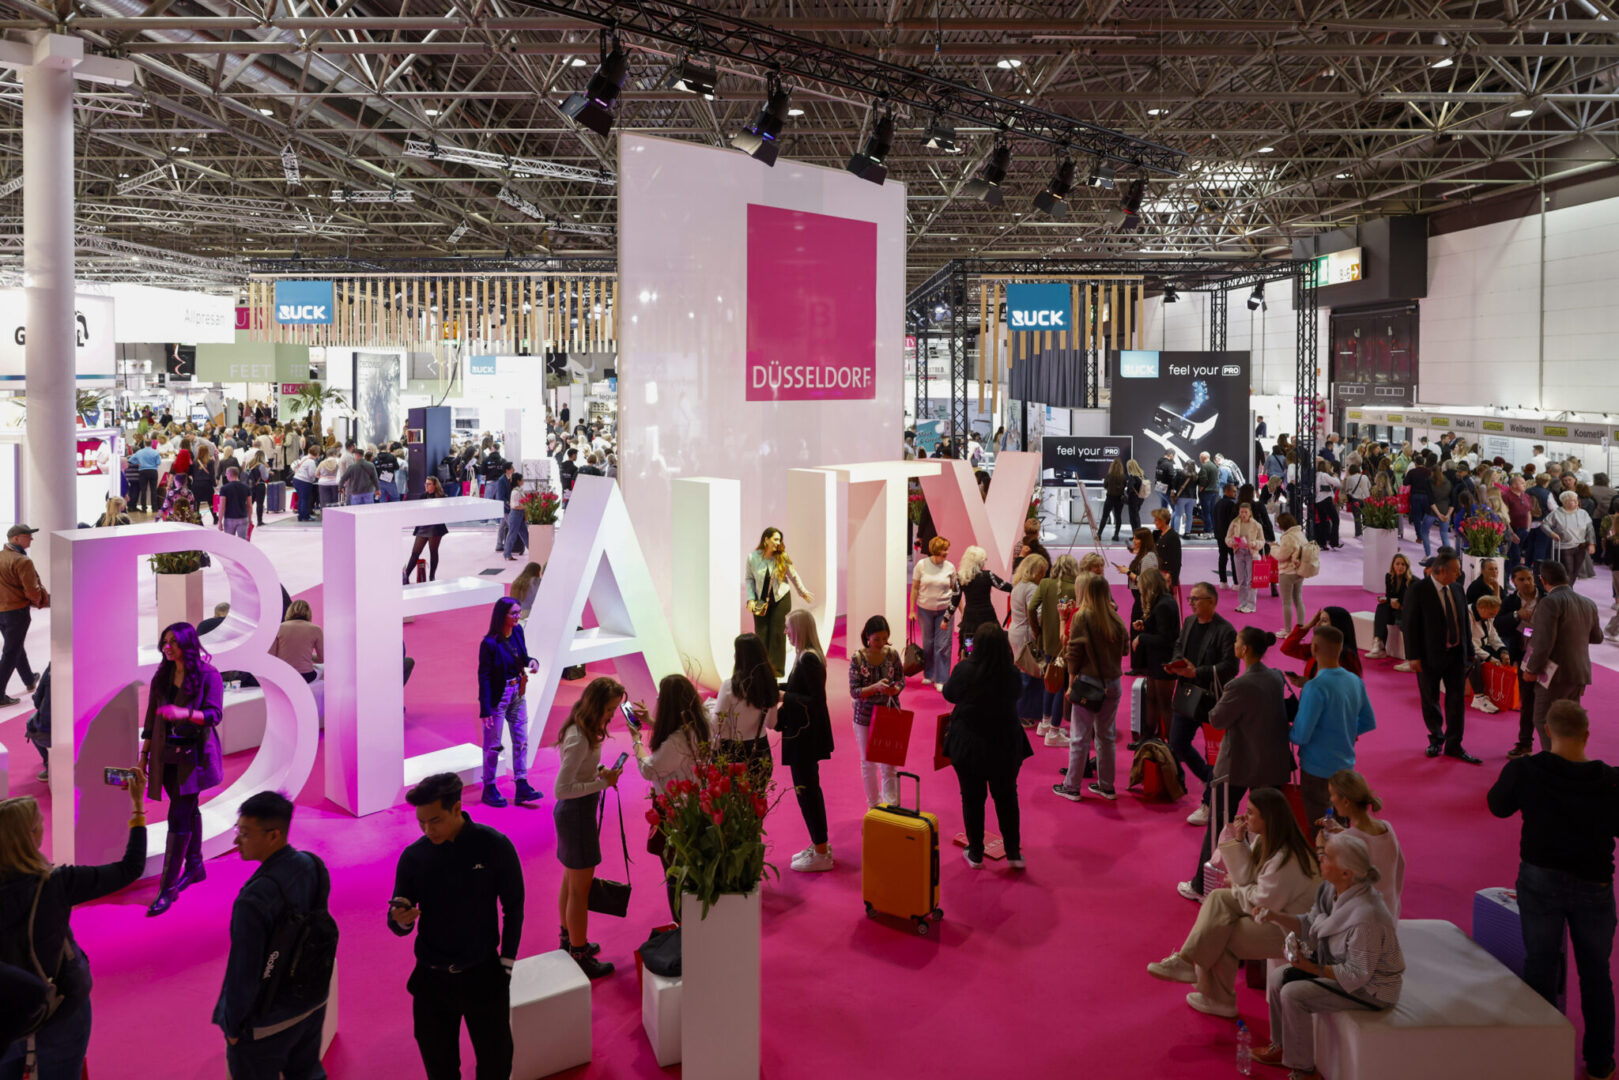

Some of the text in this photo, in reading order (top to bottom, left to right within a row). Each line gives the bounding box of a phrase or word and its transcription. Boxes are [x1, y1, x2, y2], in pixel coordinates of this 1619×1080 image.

[230, 364, 272, 378] FEET
[752, 361, 871, 388] DÜSSELDORF
[1169, 364, 1239, 377] feel your PRO
[1057, 445, 1075, 455] feel
[1078, 447, 1100, 457] your
[50, 451, 1042, 879] BEAUTY
